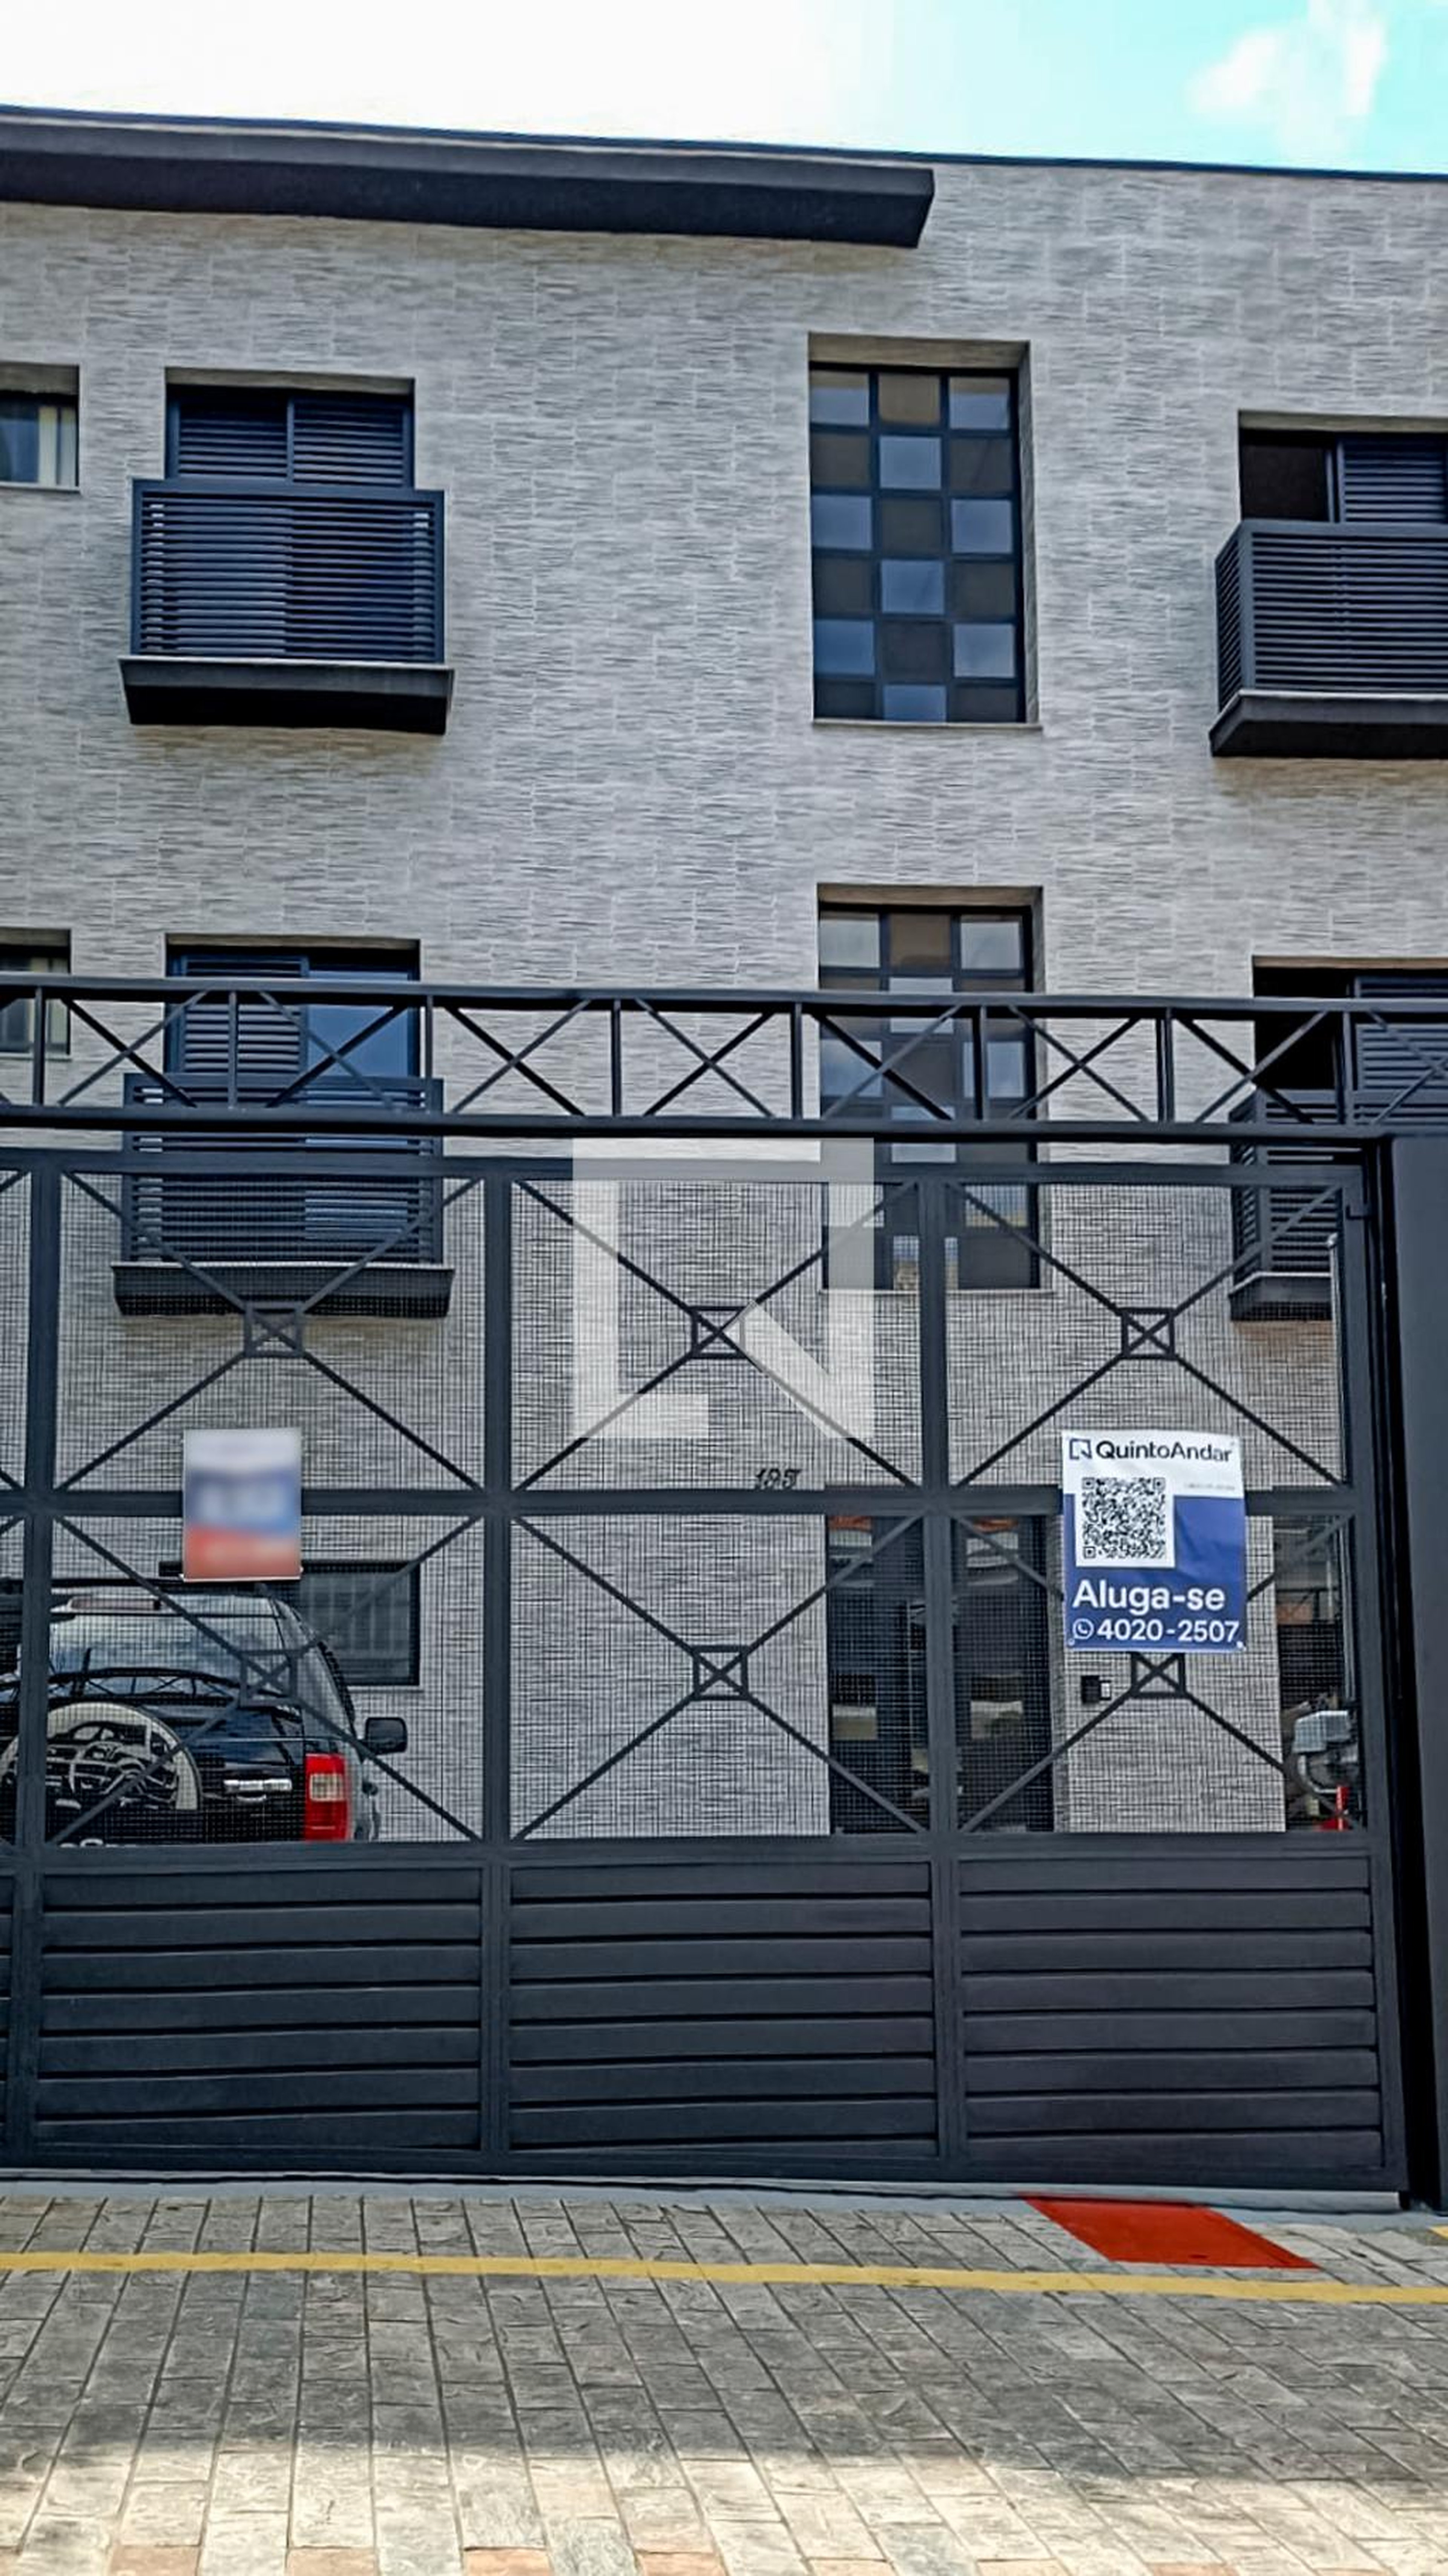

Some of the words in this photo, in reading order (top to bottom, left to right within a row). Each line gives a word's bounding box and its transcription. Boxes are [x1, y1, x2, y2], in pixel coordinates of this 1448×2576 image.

[1096, 1440, 1232, 1462] QuintoAndar
[1072, 1580, 1225, 1616] Aluga-se
[1097, 1619, 1240, 1642] 4020-2507
